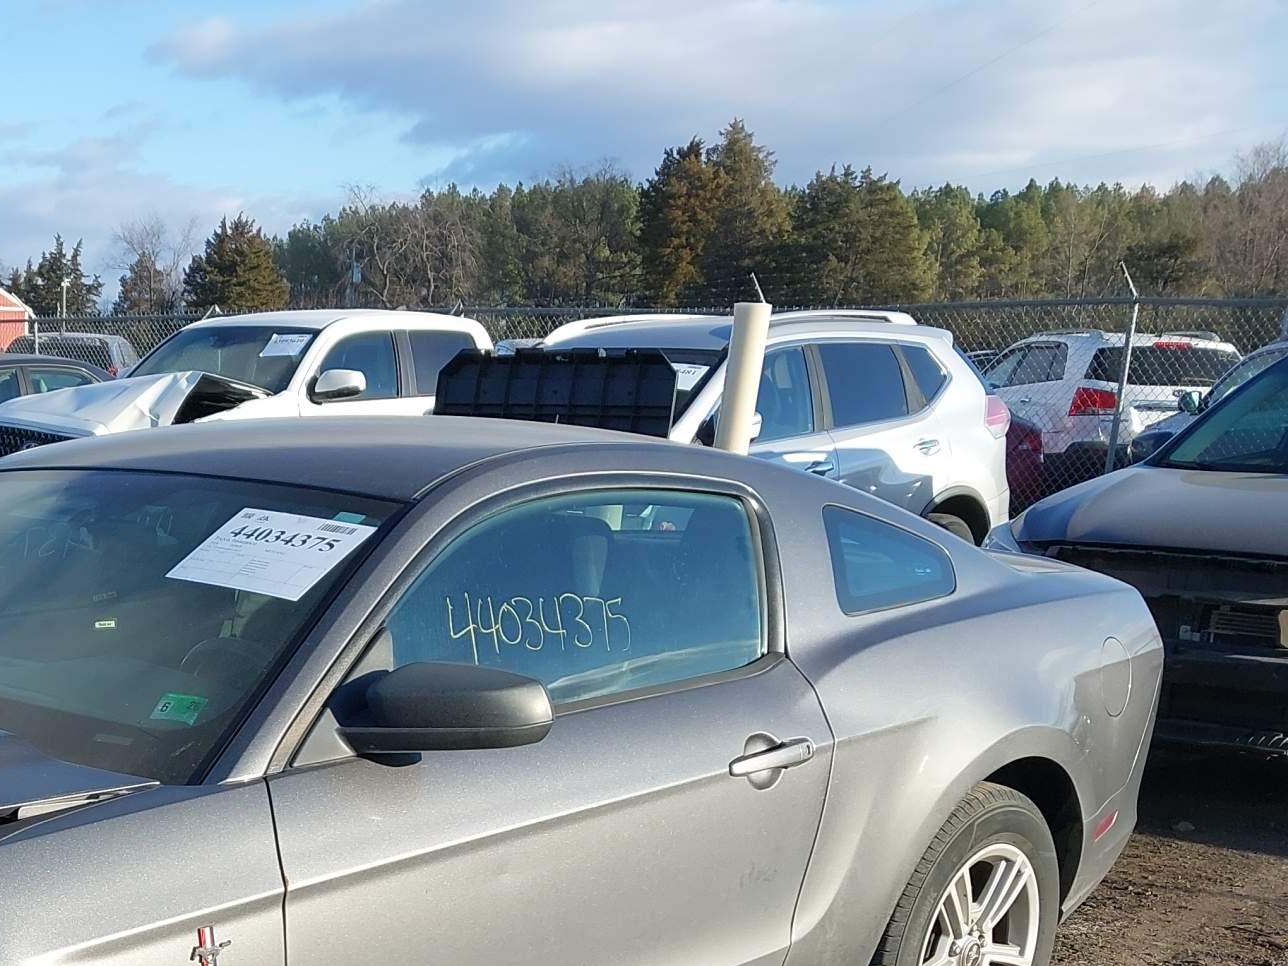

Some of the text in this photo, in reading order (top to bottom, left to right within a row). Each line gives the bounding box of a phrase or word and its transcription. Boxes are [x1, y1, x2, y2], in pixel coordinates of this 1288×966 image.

[230, 524, 342, 553] 44034375
[446, 592, 632, 666] 44034375
[159, 701, 172, 713] 6
